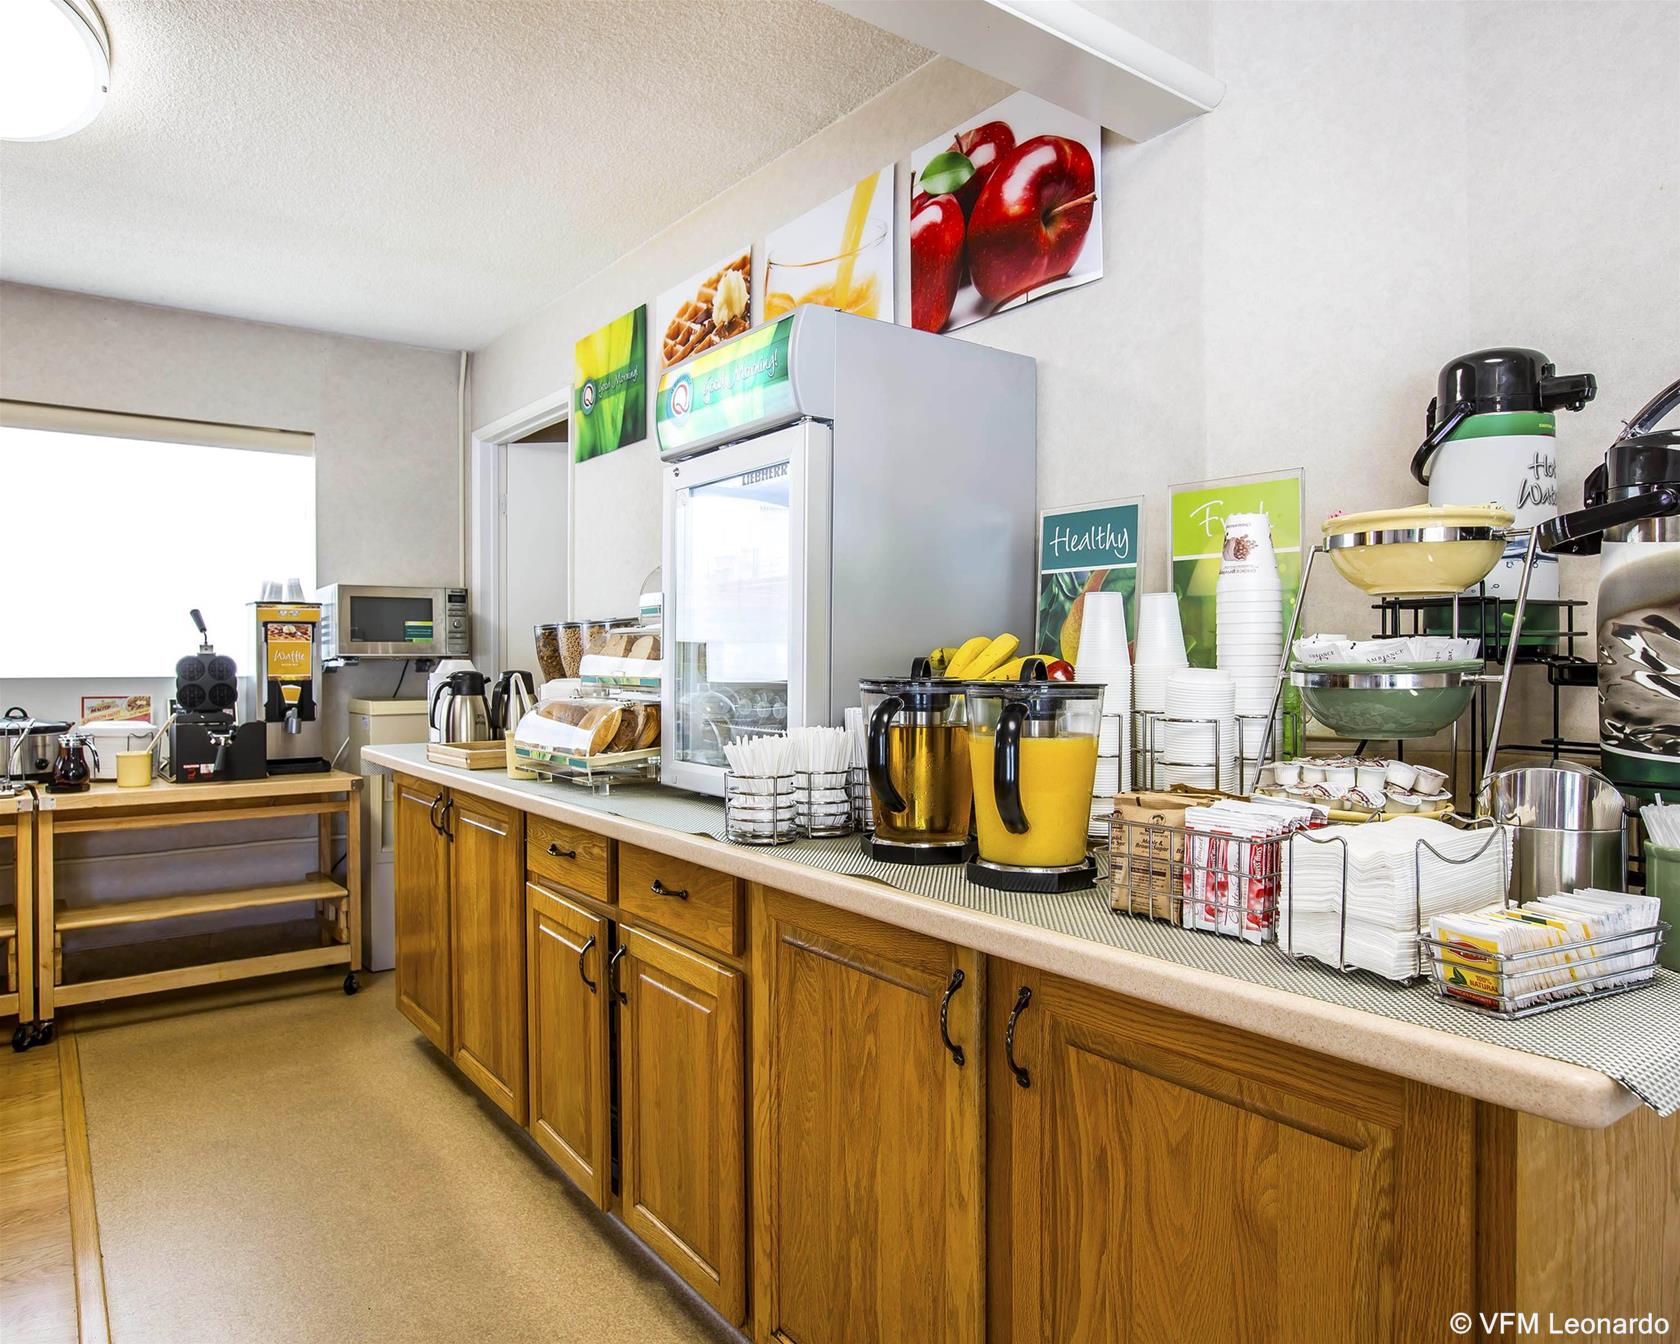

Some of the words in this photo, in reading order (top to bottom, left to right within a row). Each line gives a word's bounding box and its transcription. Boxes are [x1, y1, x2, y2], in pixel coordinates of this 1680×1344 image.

[742, 462, 788, 486] LIEBHERR
[1517, 479, 1557, 509] Wat
[1049, 523, 1129, 559] Healthy
[273, 649, 305, 663] Waffle
